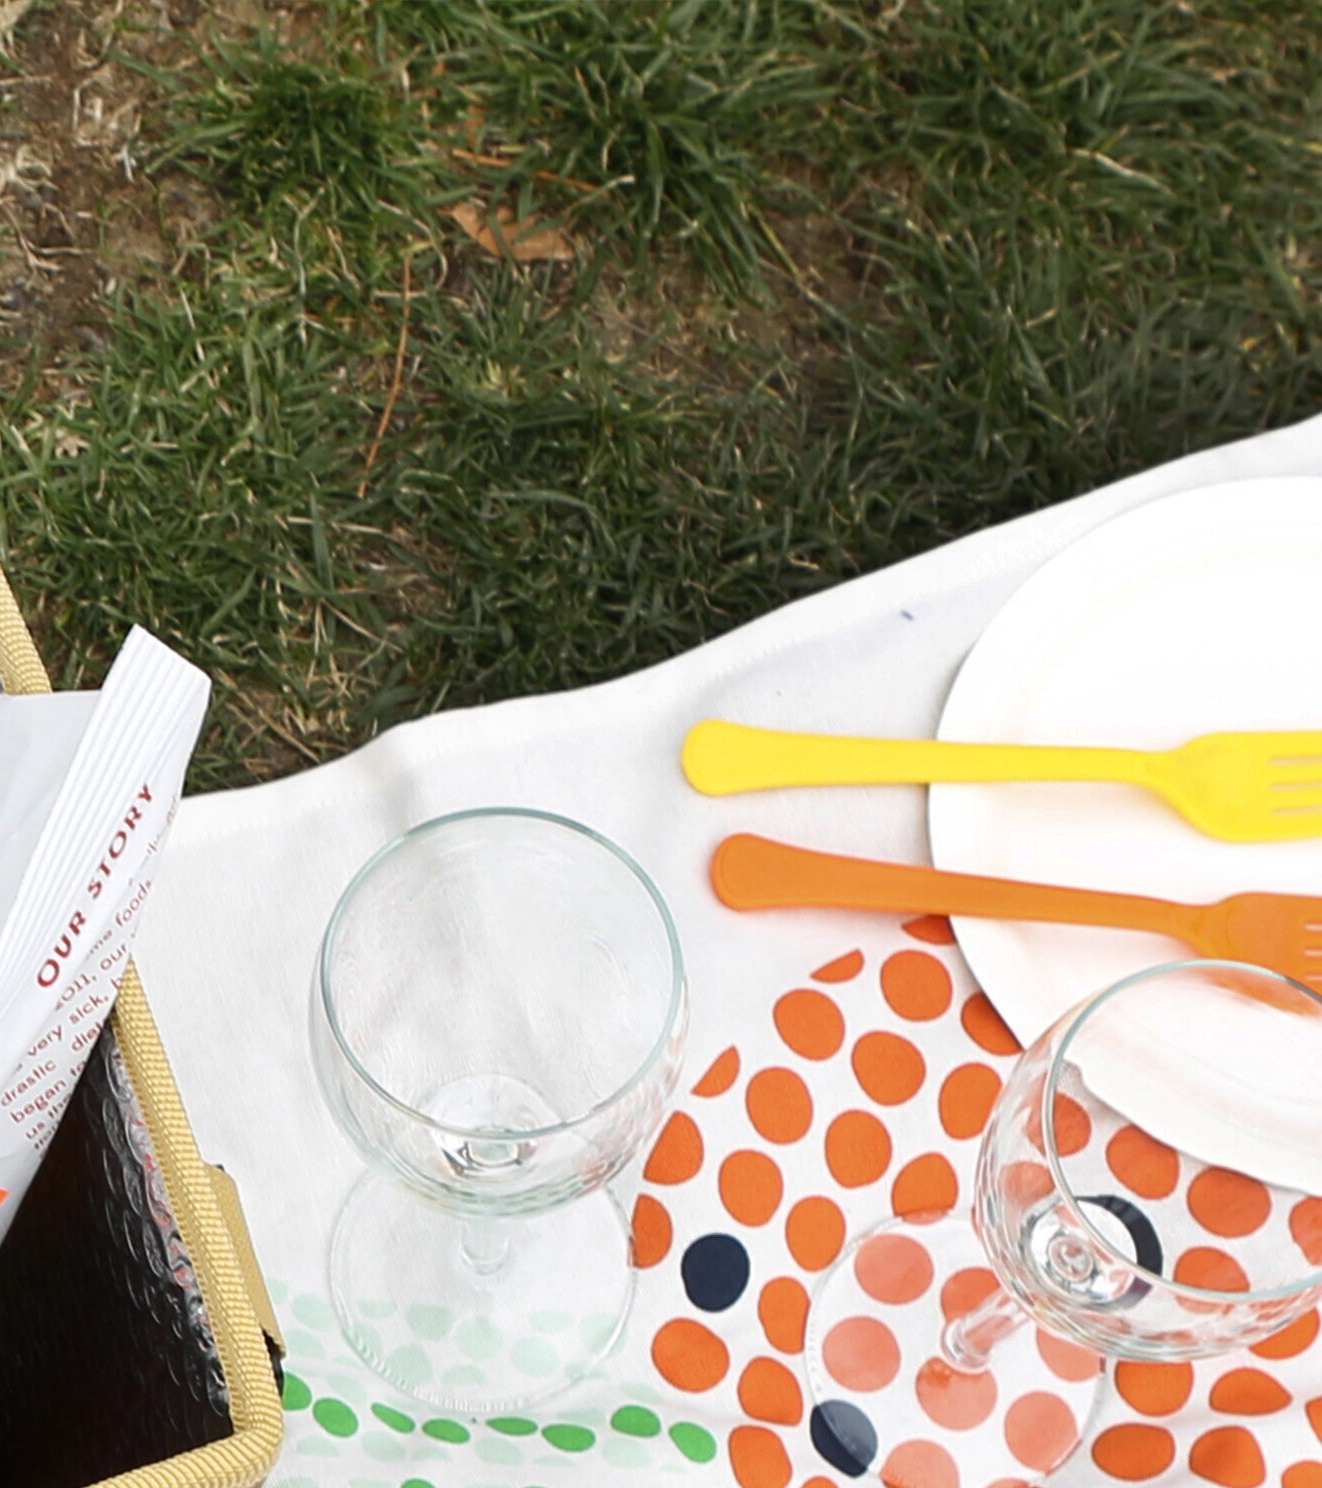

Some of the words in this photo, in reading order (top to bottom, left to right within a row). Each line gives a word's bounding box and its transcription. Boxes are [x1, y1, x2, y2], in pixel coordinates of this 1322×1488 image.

[37, 910, 87, 988] OUR
[87, 783, 153, 900] STORY
[27, 1024, 63, 1057] very
[0, 1059, 57, 1107] drastic
[10, 1079, 67, 1123] began
